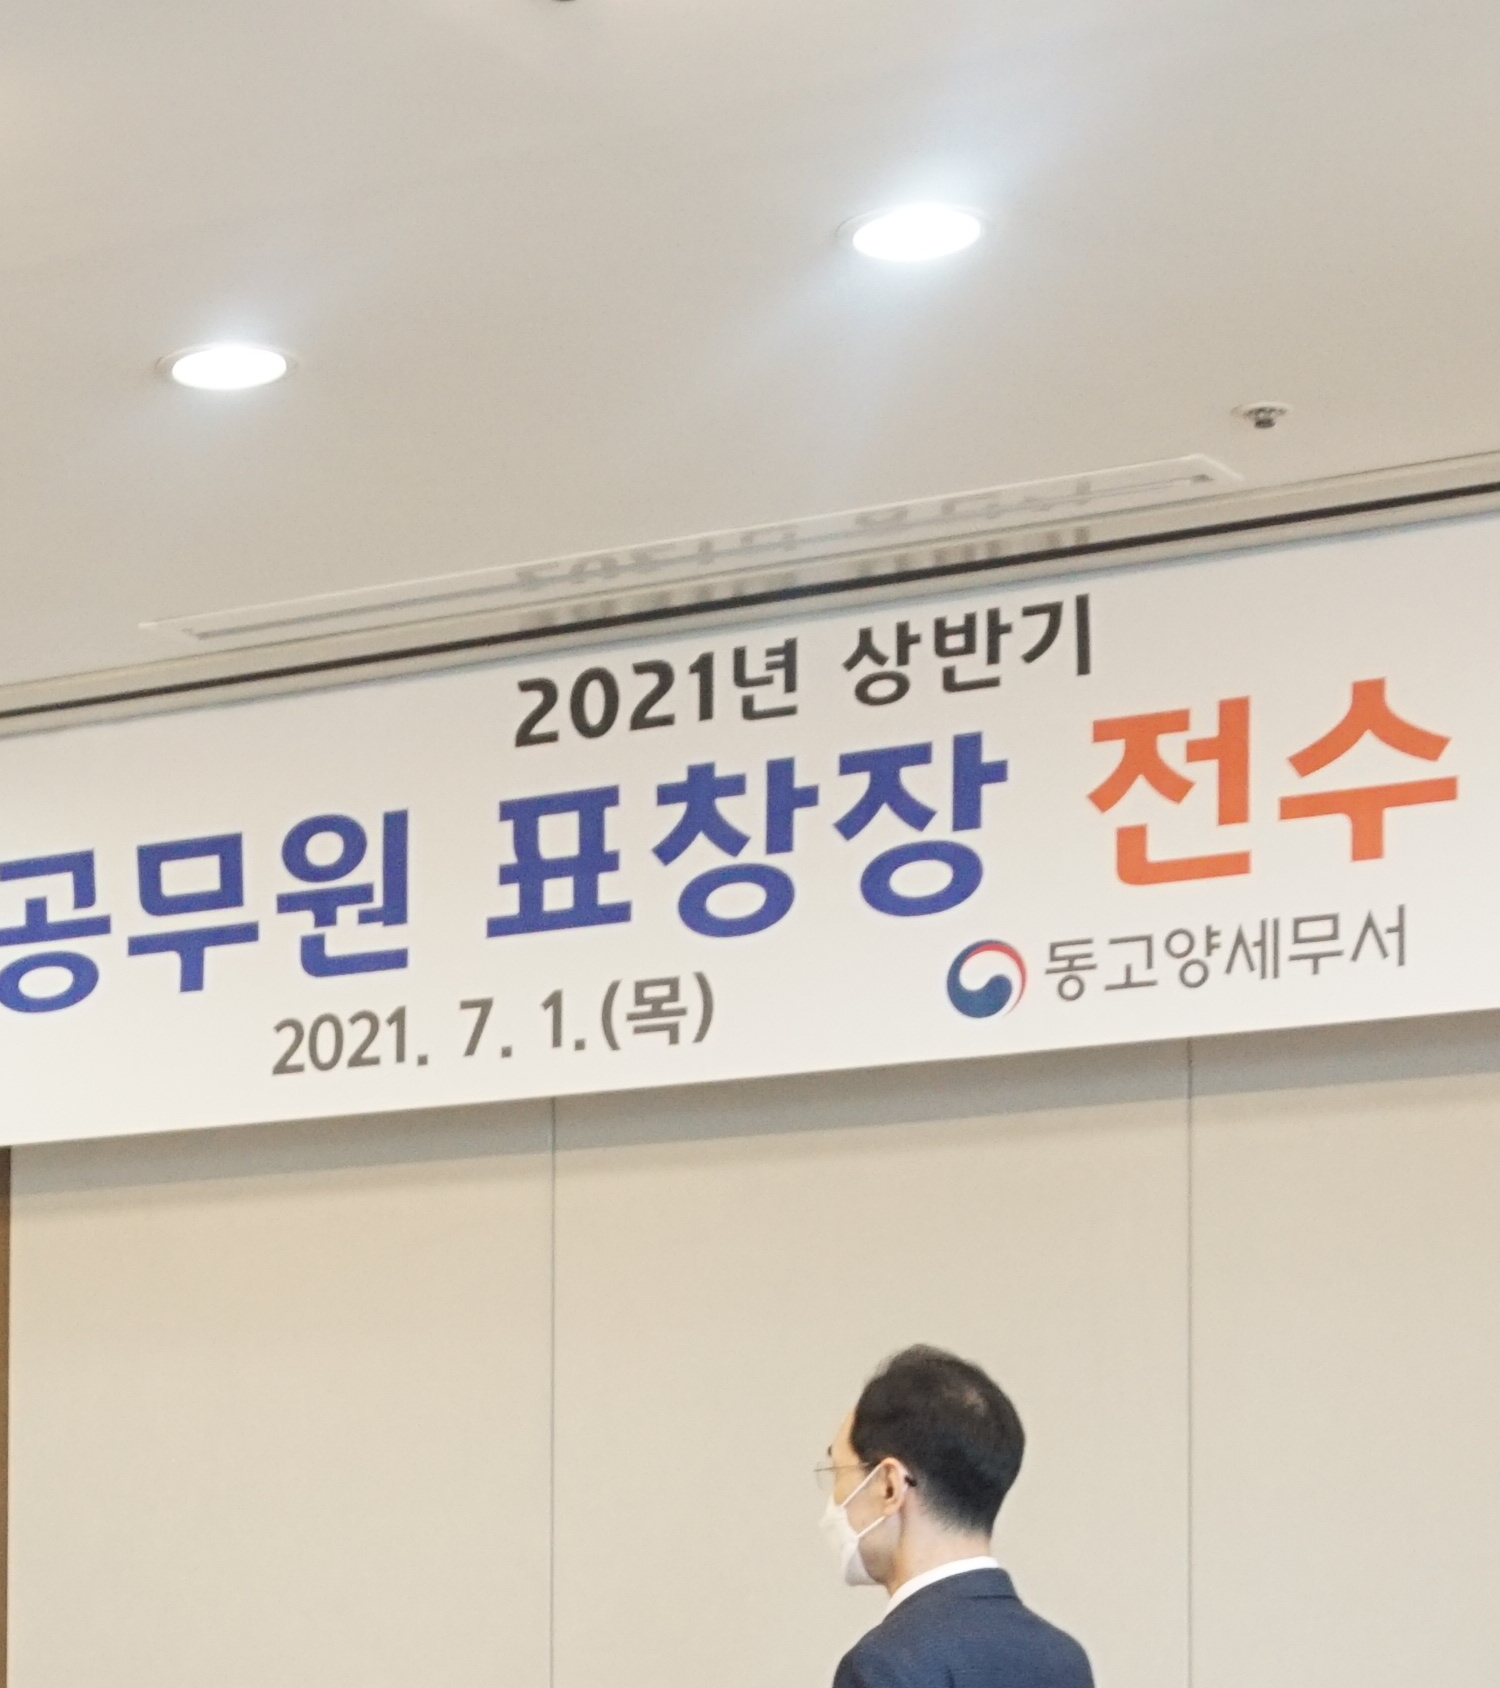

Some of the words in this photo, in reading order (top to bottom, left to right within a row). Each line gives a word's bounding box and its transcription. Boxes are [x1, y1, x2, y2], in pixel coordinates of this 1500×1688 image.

[514, 636, 798, 748] 2021년
[842, 593, 1092, 706] 상반기
[486, 731, 1009, 938] 표창장
[1086, 676, 1458, 886] 전수
[1044, 903, 1407, 1003] 동고양세무서
[271, 1004, 430, 1076] 2021.
[458, 997, 513, 1058] 7.
